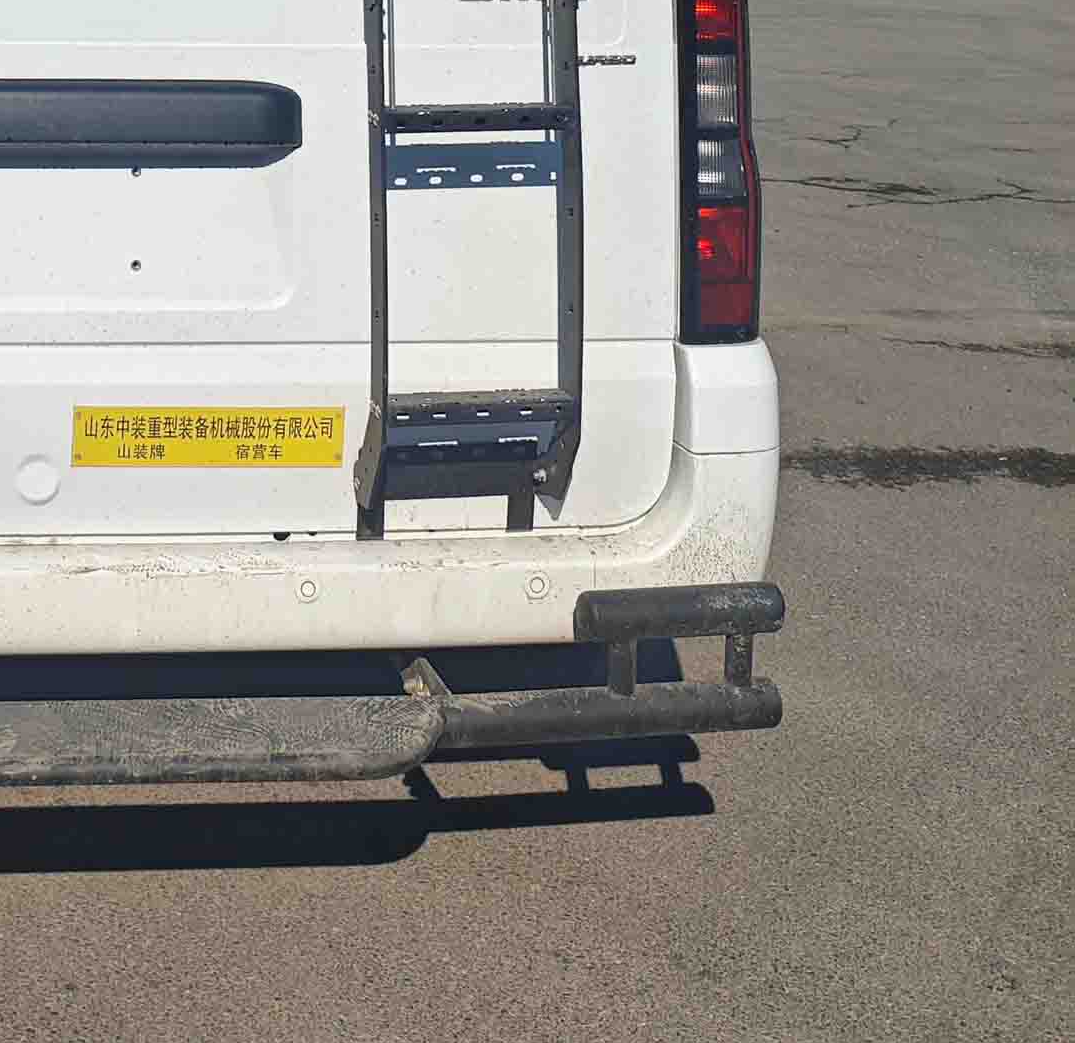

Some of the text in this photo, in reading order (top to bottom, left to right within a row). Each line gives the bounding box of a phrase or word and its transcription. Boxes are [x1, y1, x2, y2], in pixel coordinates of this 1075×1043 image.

[84, 415, 334, 441] 山东中装重型装备机械股份有限公司
[117, 443, 284, 461] 山装牌 宿营车
